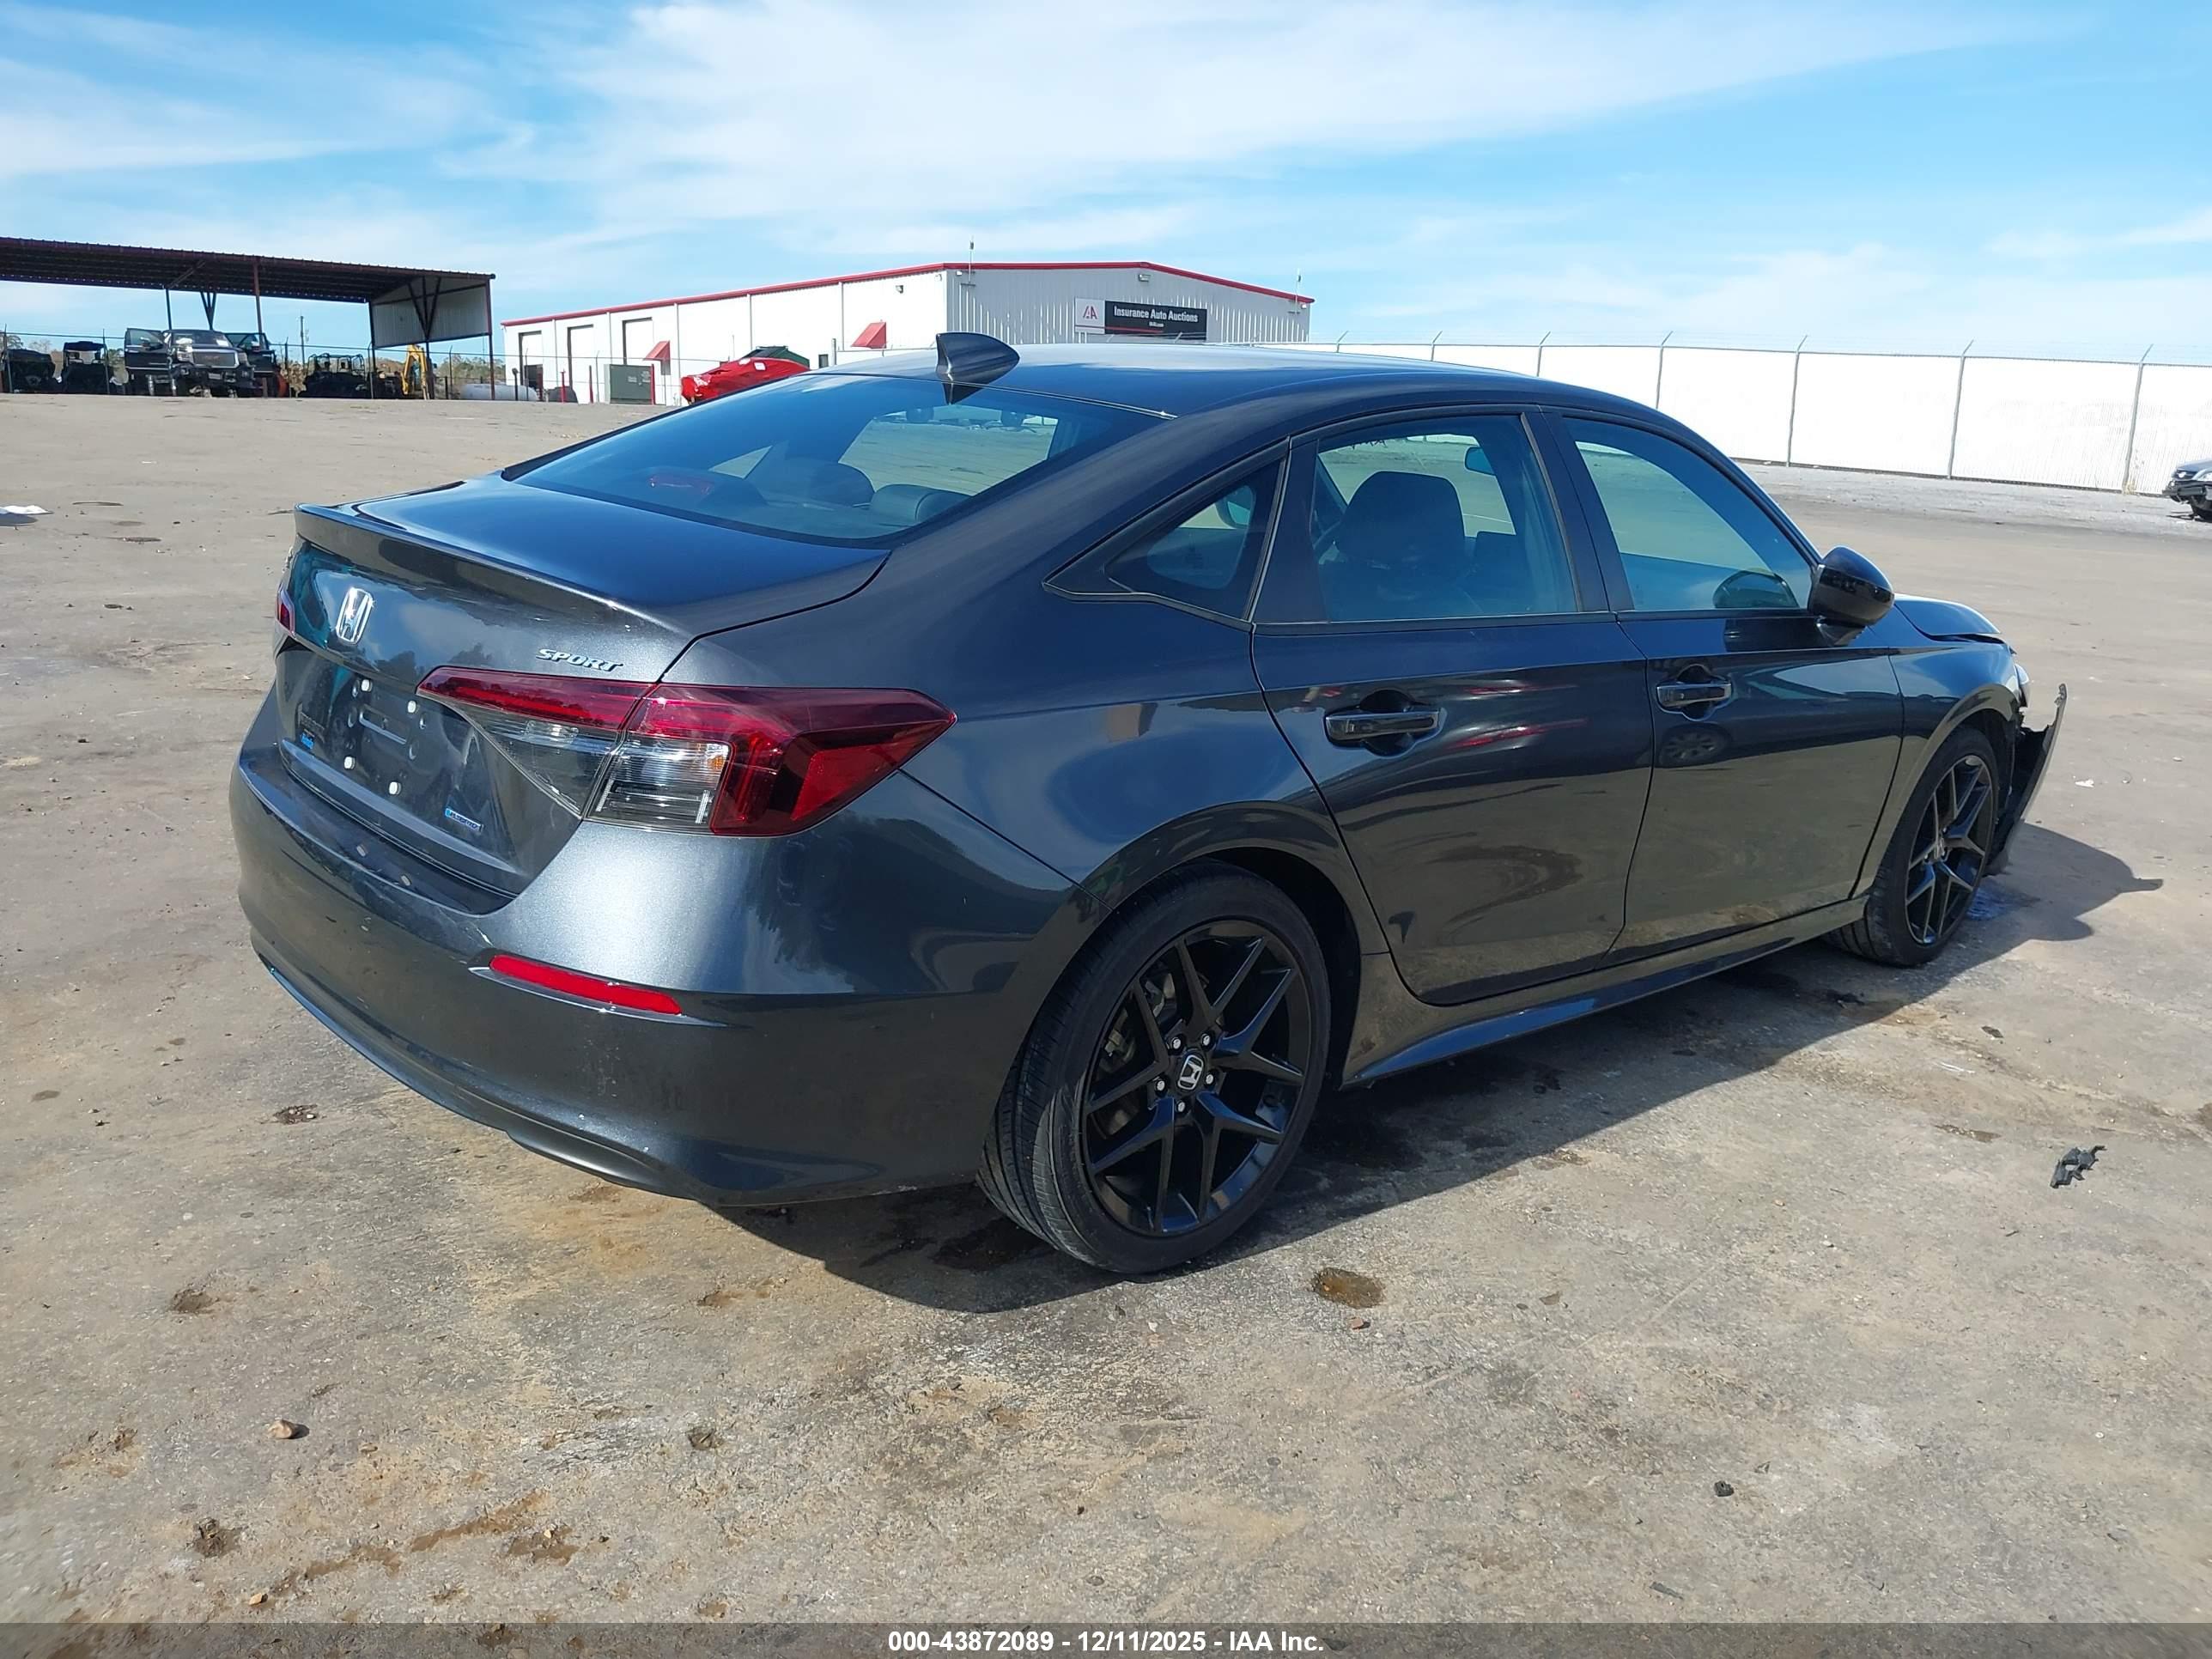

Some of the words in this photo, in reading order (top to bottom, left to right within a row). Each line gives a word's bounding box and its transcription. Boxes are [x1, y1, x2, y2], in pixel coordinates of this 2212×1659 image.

[1114, 305, 1150, 319] Insurance
[1151, 308, 1167, 320] Auto
[1168, 309, 1199, 323] Auctions
[535, 648, 624, 672] SPORT
